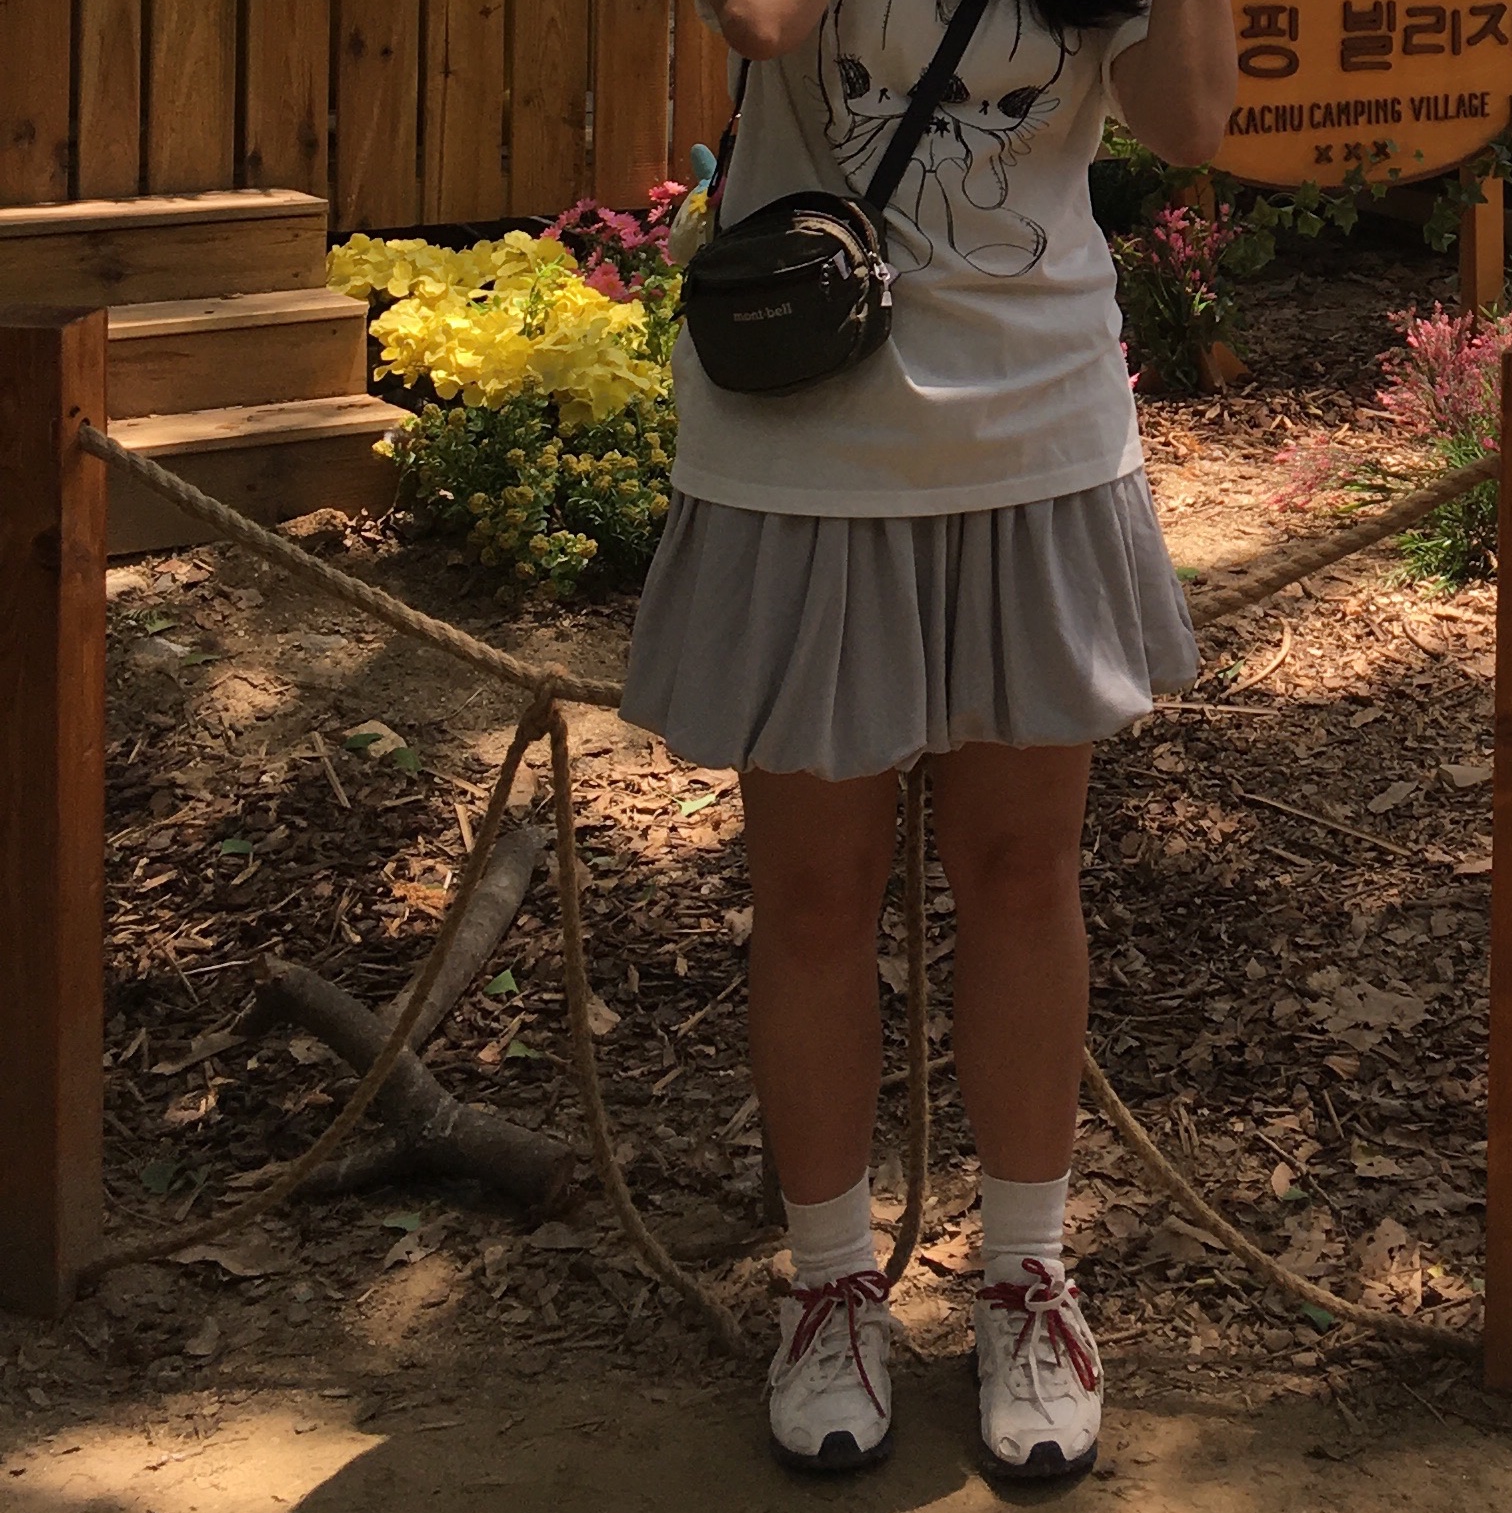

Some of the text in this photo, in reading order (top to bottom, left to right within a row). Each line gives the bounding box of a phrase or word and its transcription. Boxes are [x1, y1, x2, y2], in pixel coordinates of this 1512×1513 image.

[1237, 4, 1300, 78] 핑
[1228, 91, 1491, 136] KACHU CAMPING VILLAGE
